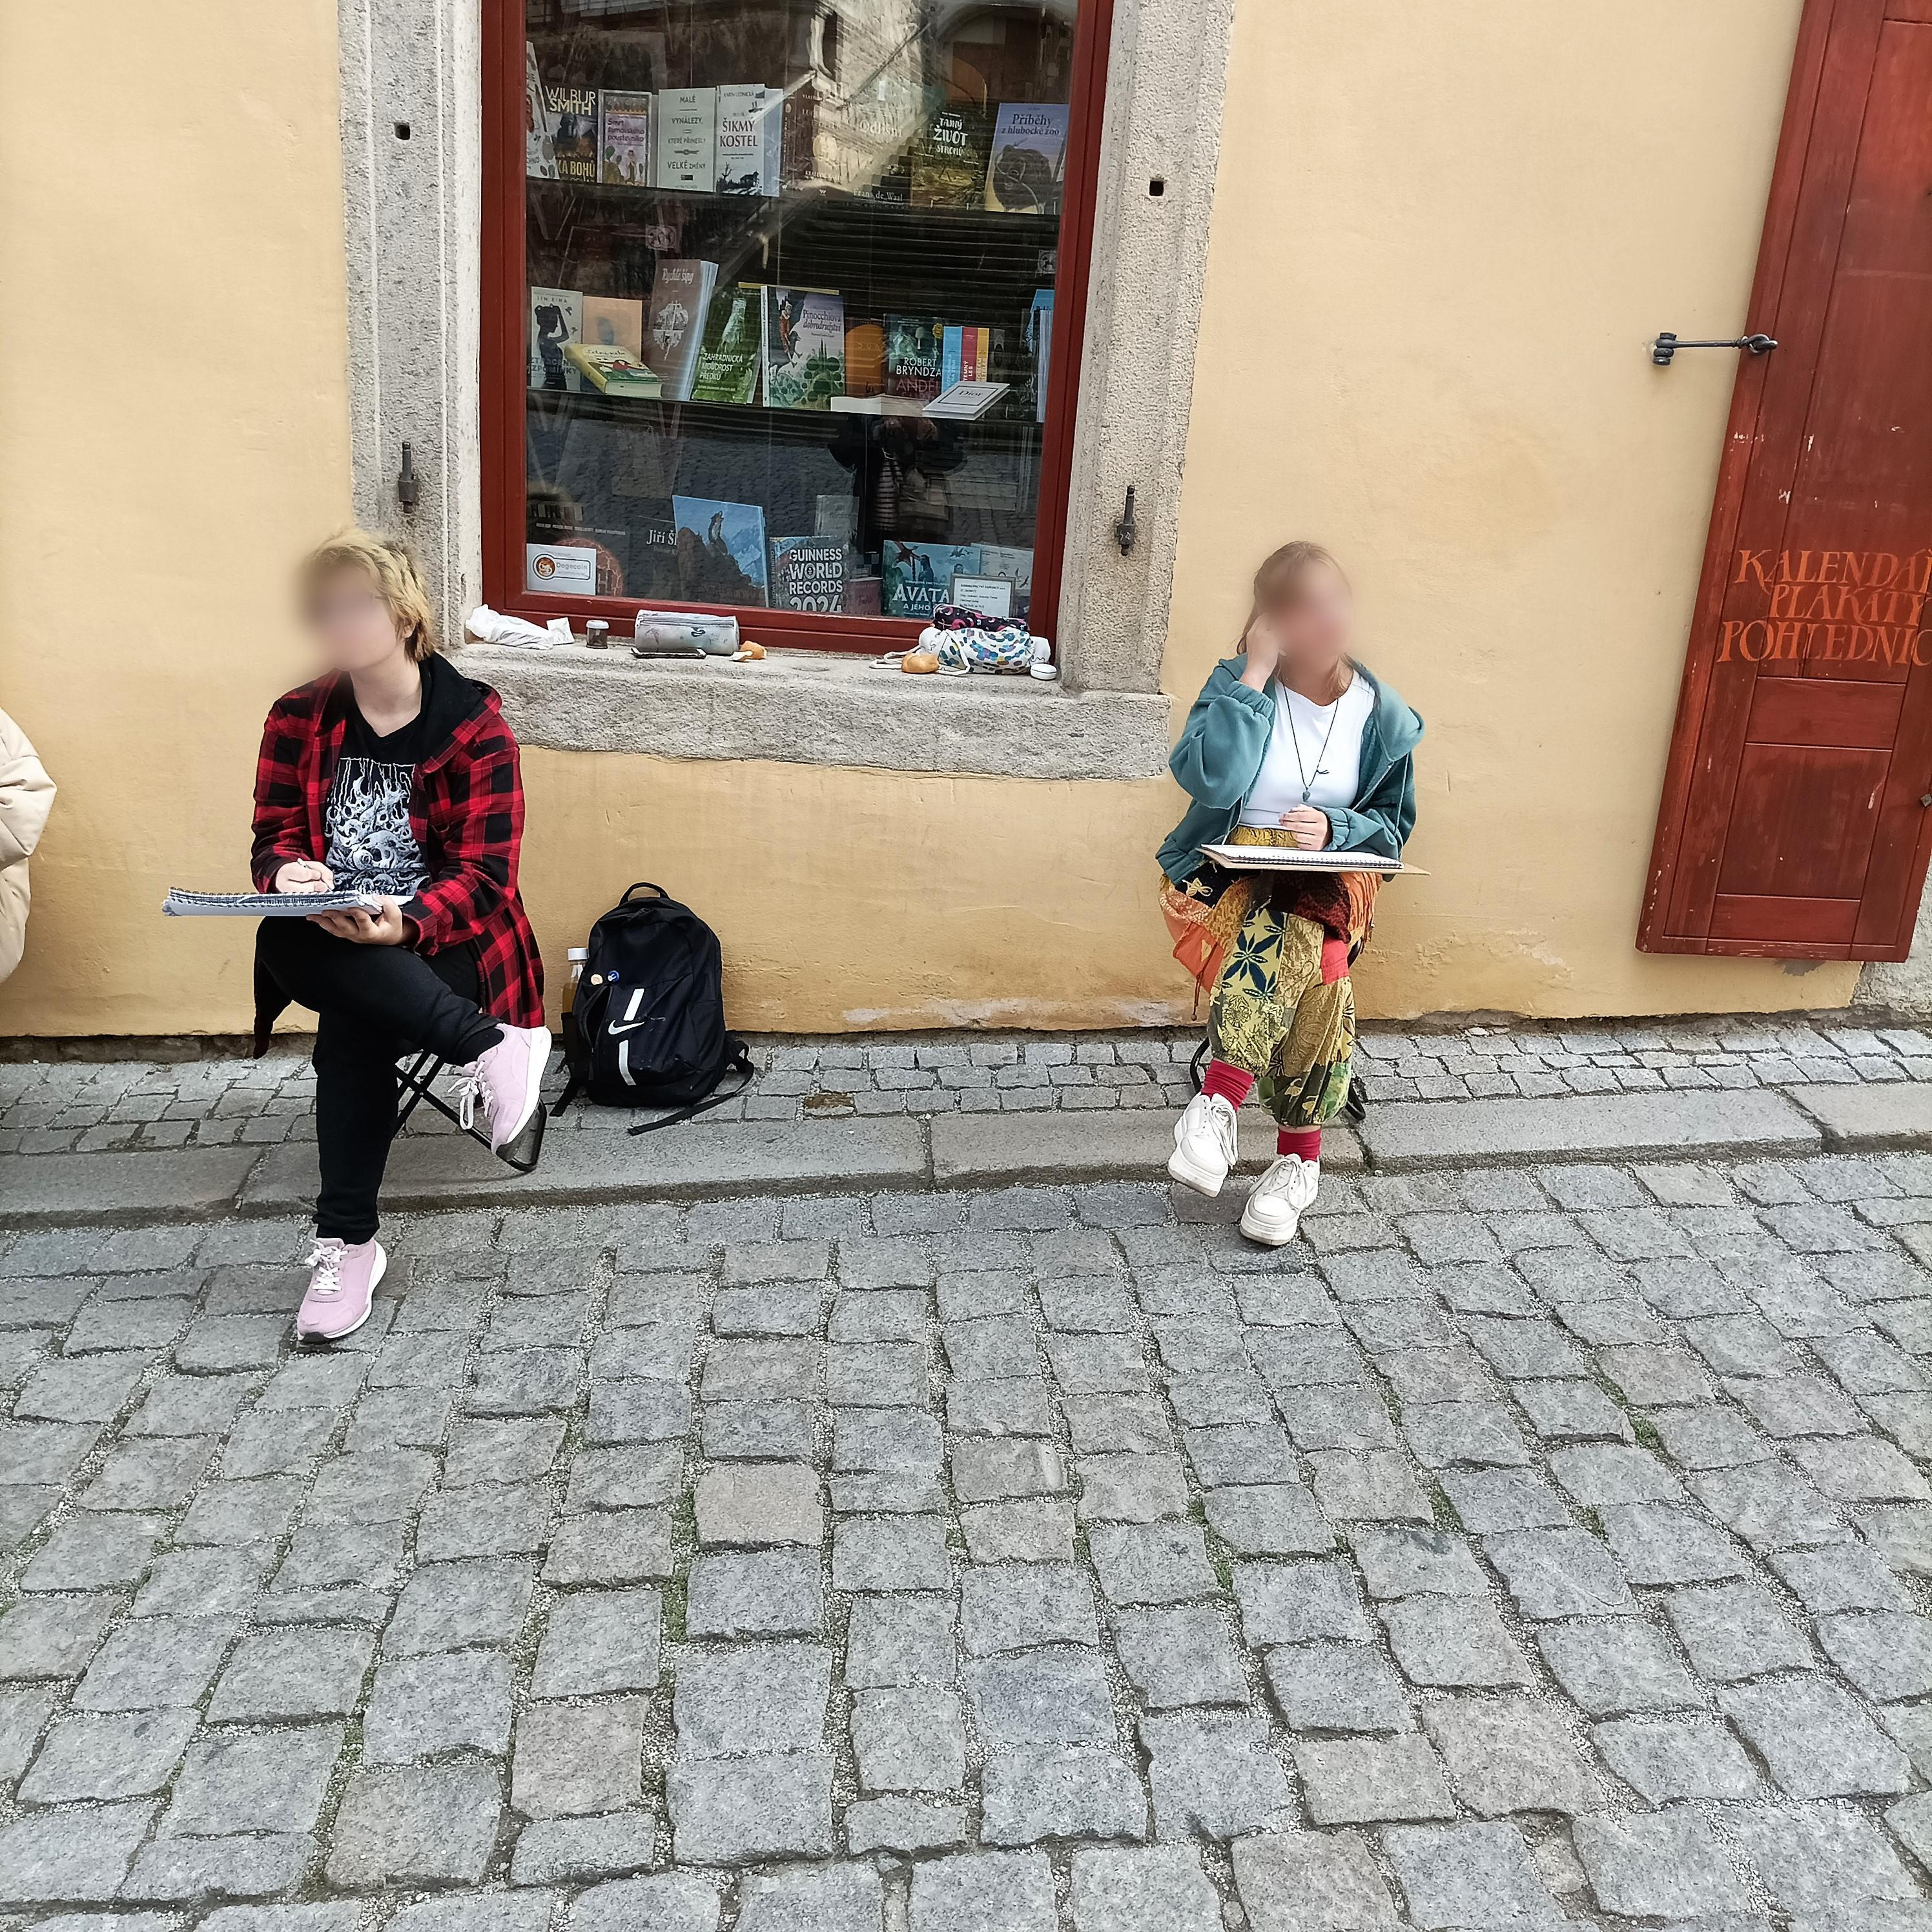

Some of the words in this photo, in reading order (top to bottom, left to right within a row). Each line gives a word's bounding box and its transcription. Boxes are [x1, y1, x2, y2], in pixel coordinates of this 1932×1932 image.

[545, 85, 596, 105] WILBUR
[549, 98, 592, 116] SMITH
[940, 118, 963, 130] TAJNÝ
[1012, 114, 1053, 127] Příběhy
[933, 124, 969, 146] ŽIVOT
[1007, 126, 1043, 135] hlubocké
[720, 135, 758, 147] KOSTEL
[570, 160, 595, 178] BOHŮ
[668, 160, 688, 169] VELKÉ
[876, 190, 885, 200] de
[886, 192, 903, 201] Waal
[703, 353, 743, 364] ZAHRADNICKÁ
[904, 357, 937, 367] ROBERT
[896, 365, 942, 377] BRYNDZA
[646, 529, 666, 545] Jiří
[790, 548, 843, 561] GUINNESS
[789, 562, 843, 580] WORLD
[789, 581, 843, 595] RECORDS
[892, 582, 950, 603] AVATA
[790, 595, 843, 613] 2024
